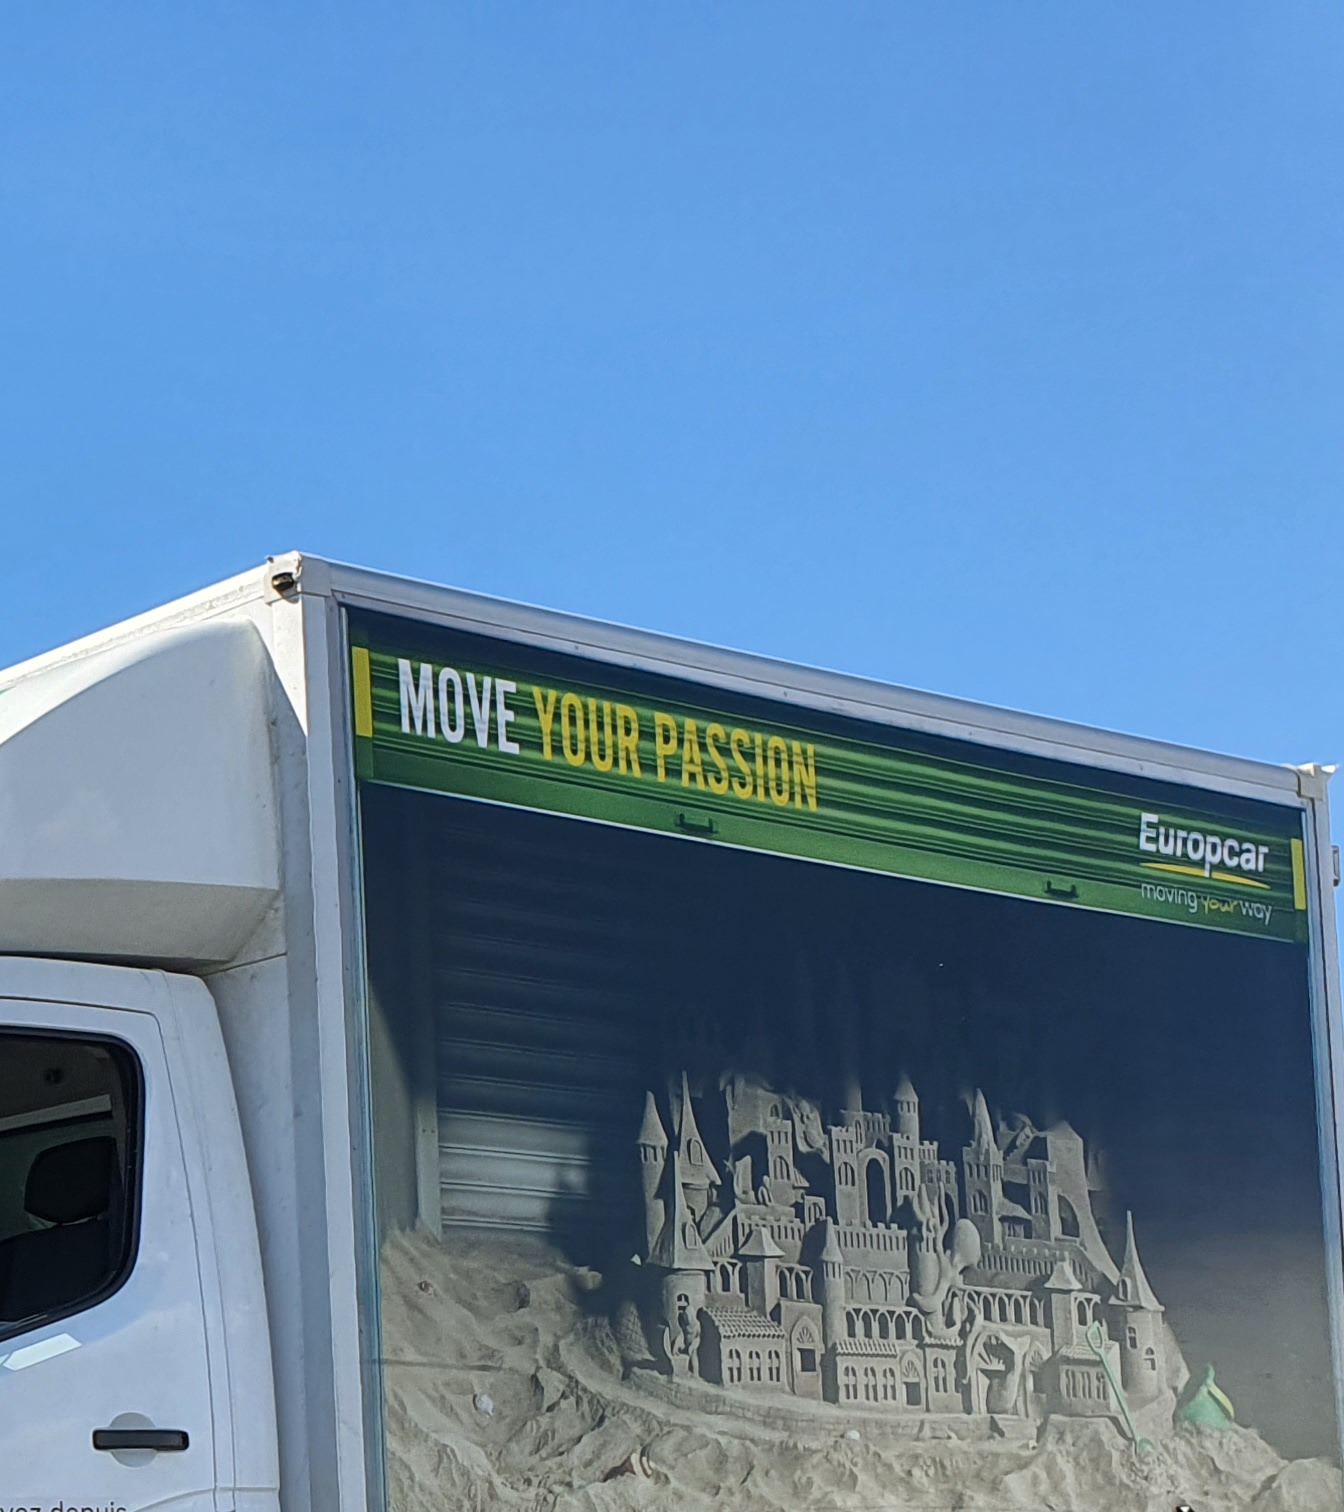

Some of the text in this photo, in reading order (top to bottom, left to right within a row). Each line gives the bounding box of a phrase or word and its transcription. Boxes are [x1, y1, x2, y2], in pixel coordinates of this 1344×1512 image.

[397, 657, 818, 812] MOVE YOUR PASSION
[1139, 811, 1269, 878] Europcar
[1140, 883, 1273, 926] moving your way
